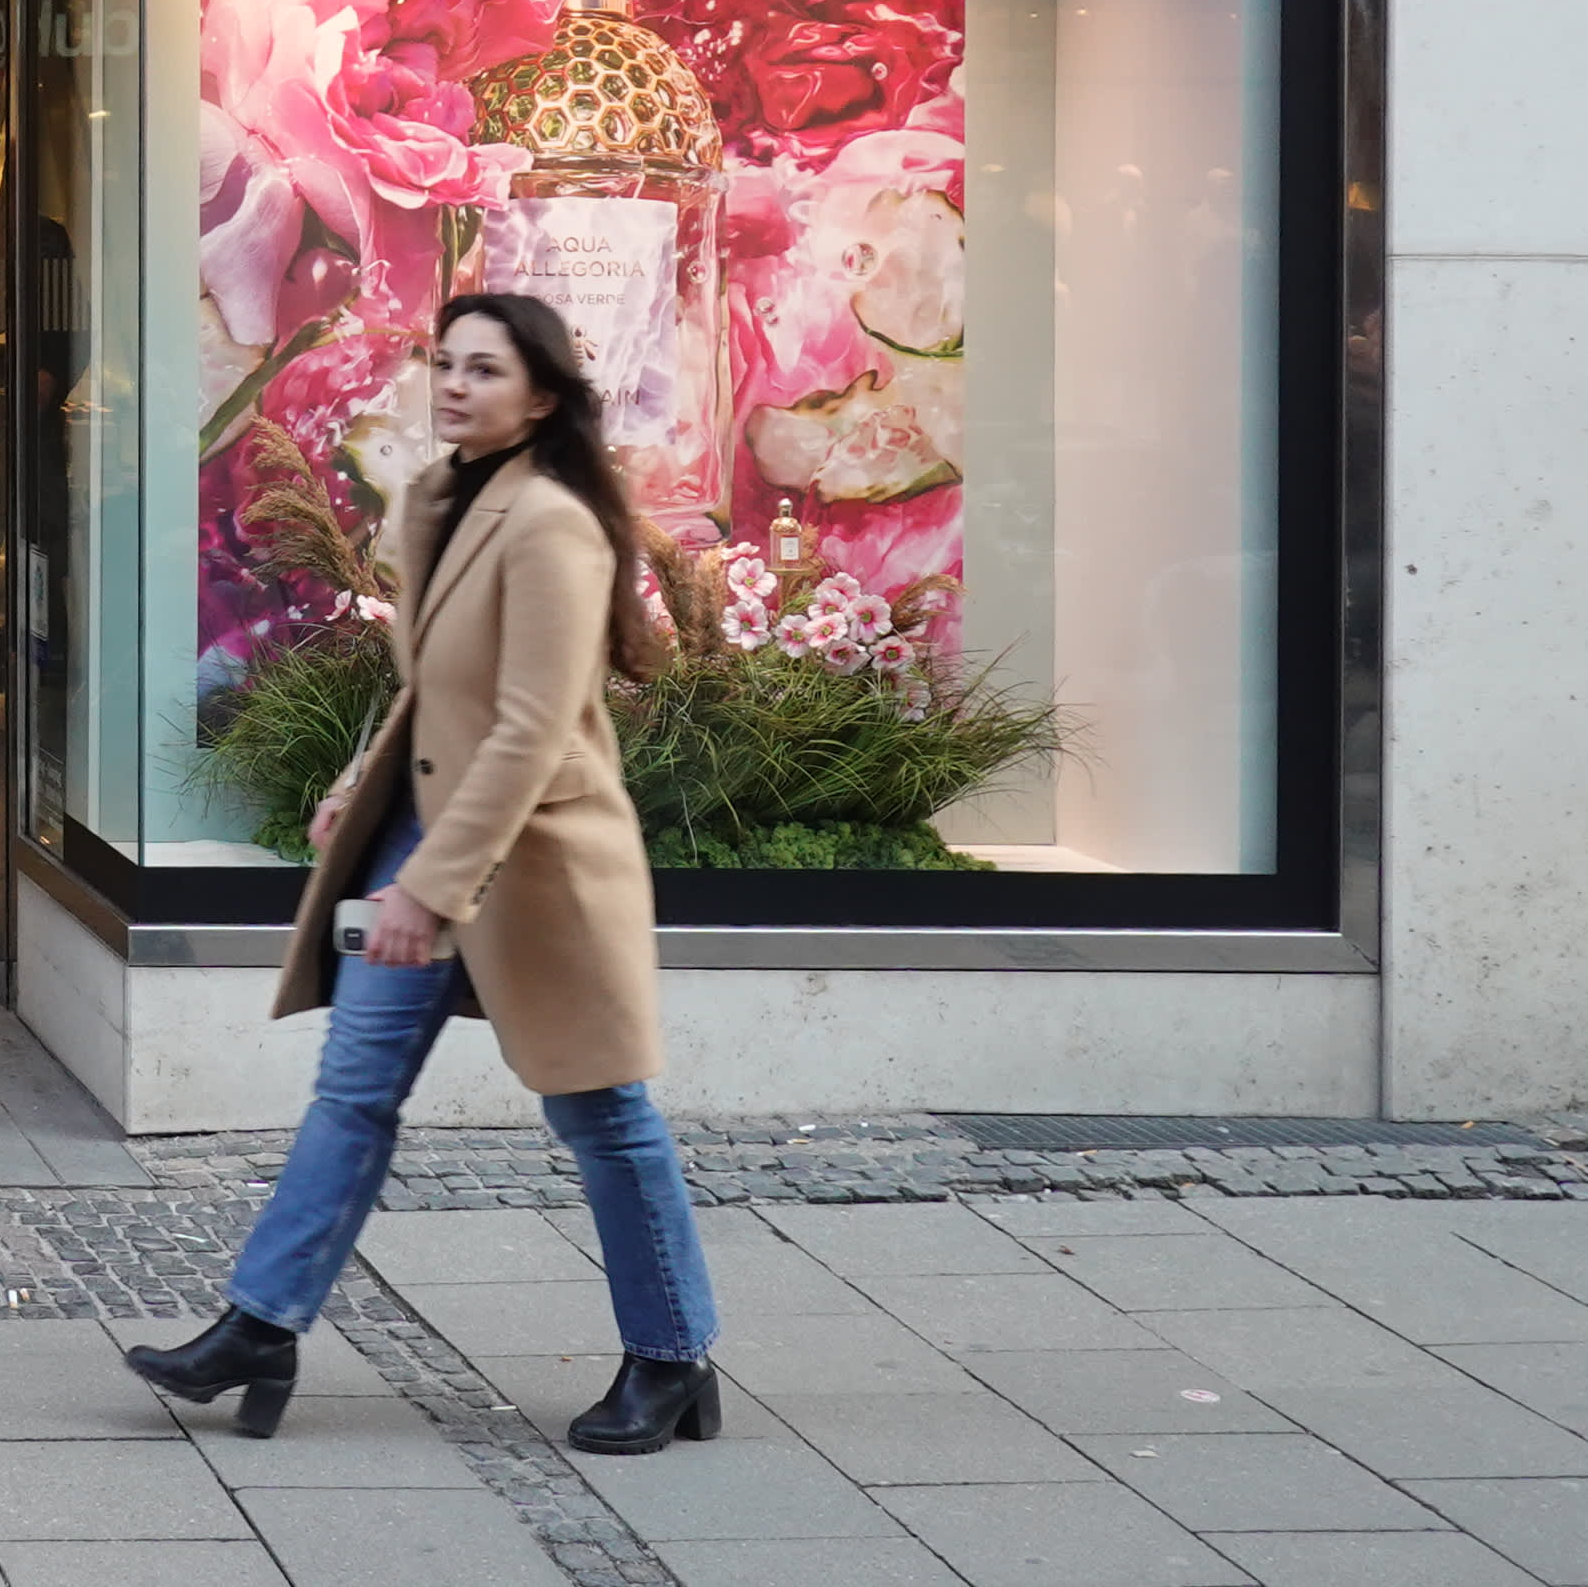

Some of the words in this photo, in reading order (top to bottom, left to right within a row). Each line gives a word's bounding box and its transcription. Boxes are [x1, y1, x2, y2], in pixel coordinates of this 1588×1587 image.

[546, 236, 613, 253] AQUA
[514, 260, 645, 278] ALLEGORIA
[539, 293, 573, 306] OSA
